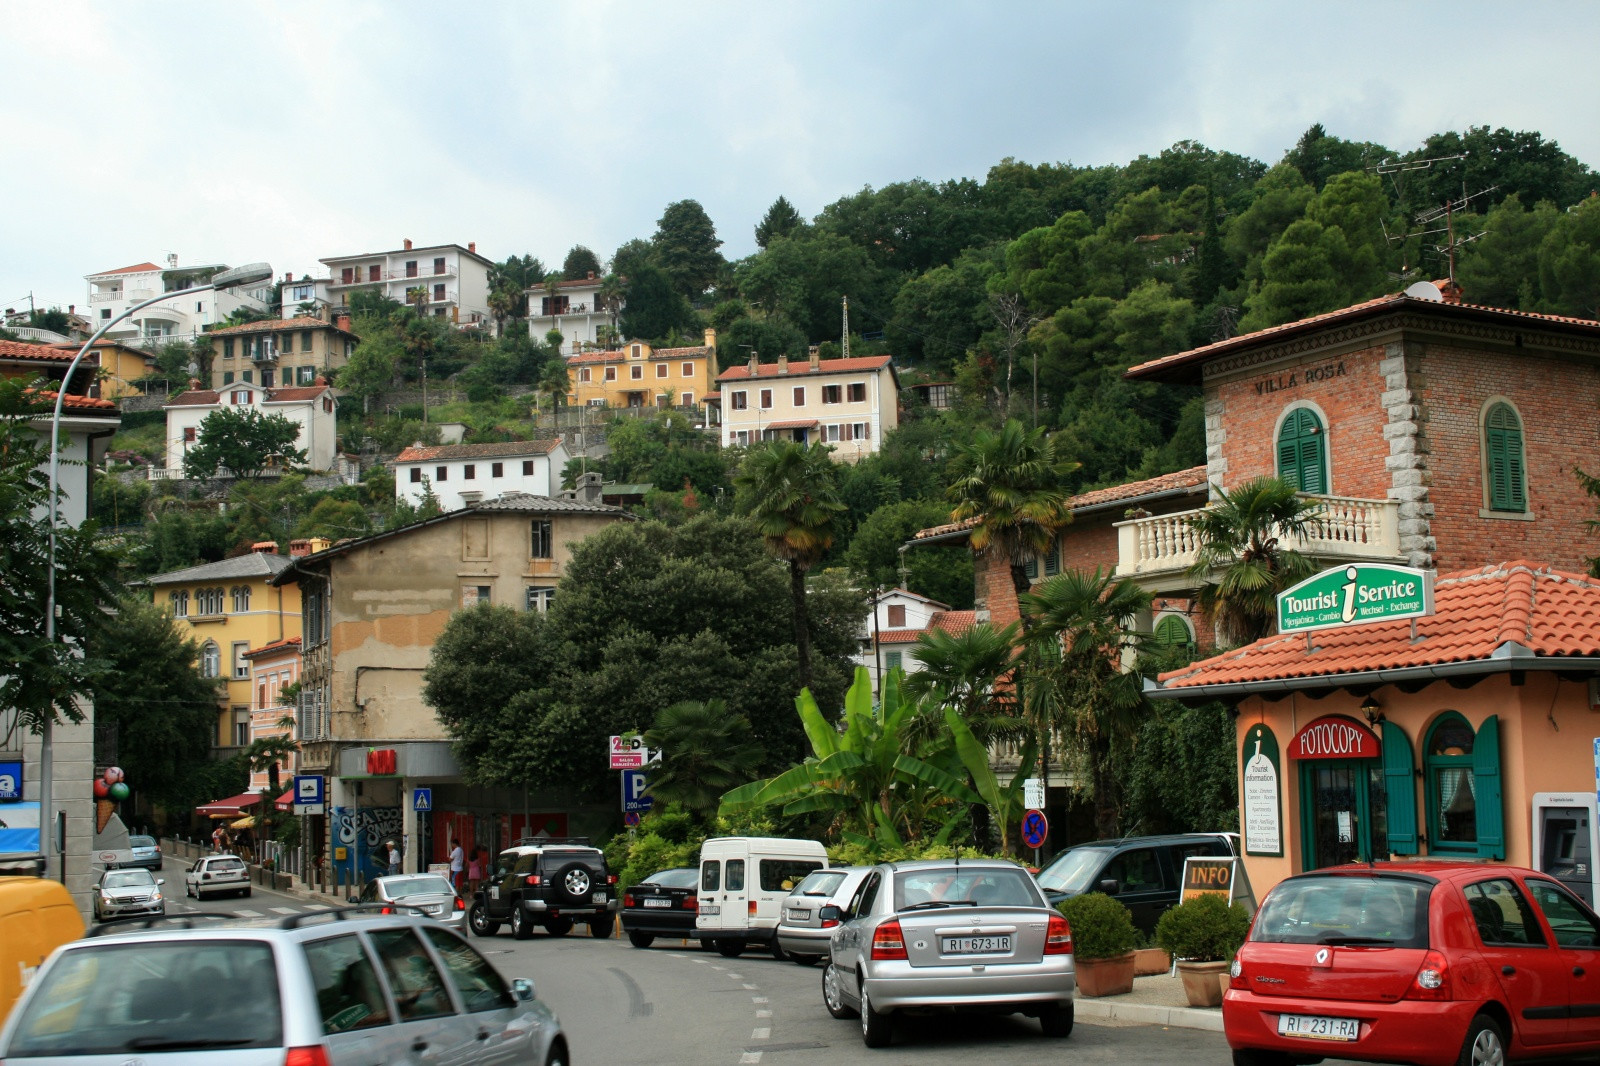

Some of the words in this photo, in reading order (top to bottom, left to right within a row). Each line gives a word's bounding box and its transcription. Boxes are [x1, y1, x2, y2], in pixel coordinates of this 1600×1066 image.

[1255, 373, 1297, 395] VILLA
[1305, 361, 1346, 384] ROSA
[1285, 590, 1338, 614] Tourist
[1358, 580, 1415, 604] Service
[1319, 611, 1341, 621] Cambio
[1360, 604, 1384, 615] Wechsel
[1390, 601, 1420, 612] Exchange
[1300, 723, 1363, 754] FOTOCOPY
[1251, 765, 1268, 773] Tourist
[632, 774, 647, 799] P
[373, 807, 403, 821] FOO
[1190, 867, 1230, 885] INFO
[950, 939, 962, 950] RI
[971, 937, 1009, 951] 673-IR
[1286, 1017, 1300, 1032] RI
[1310, 1018, 1355, 1036] 231-RA
